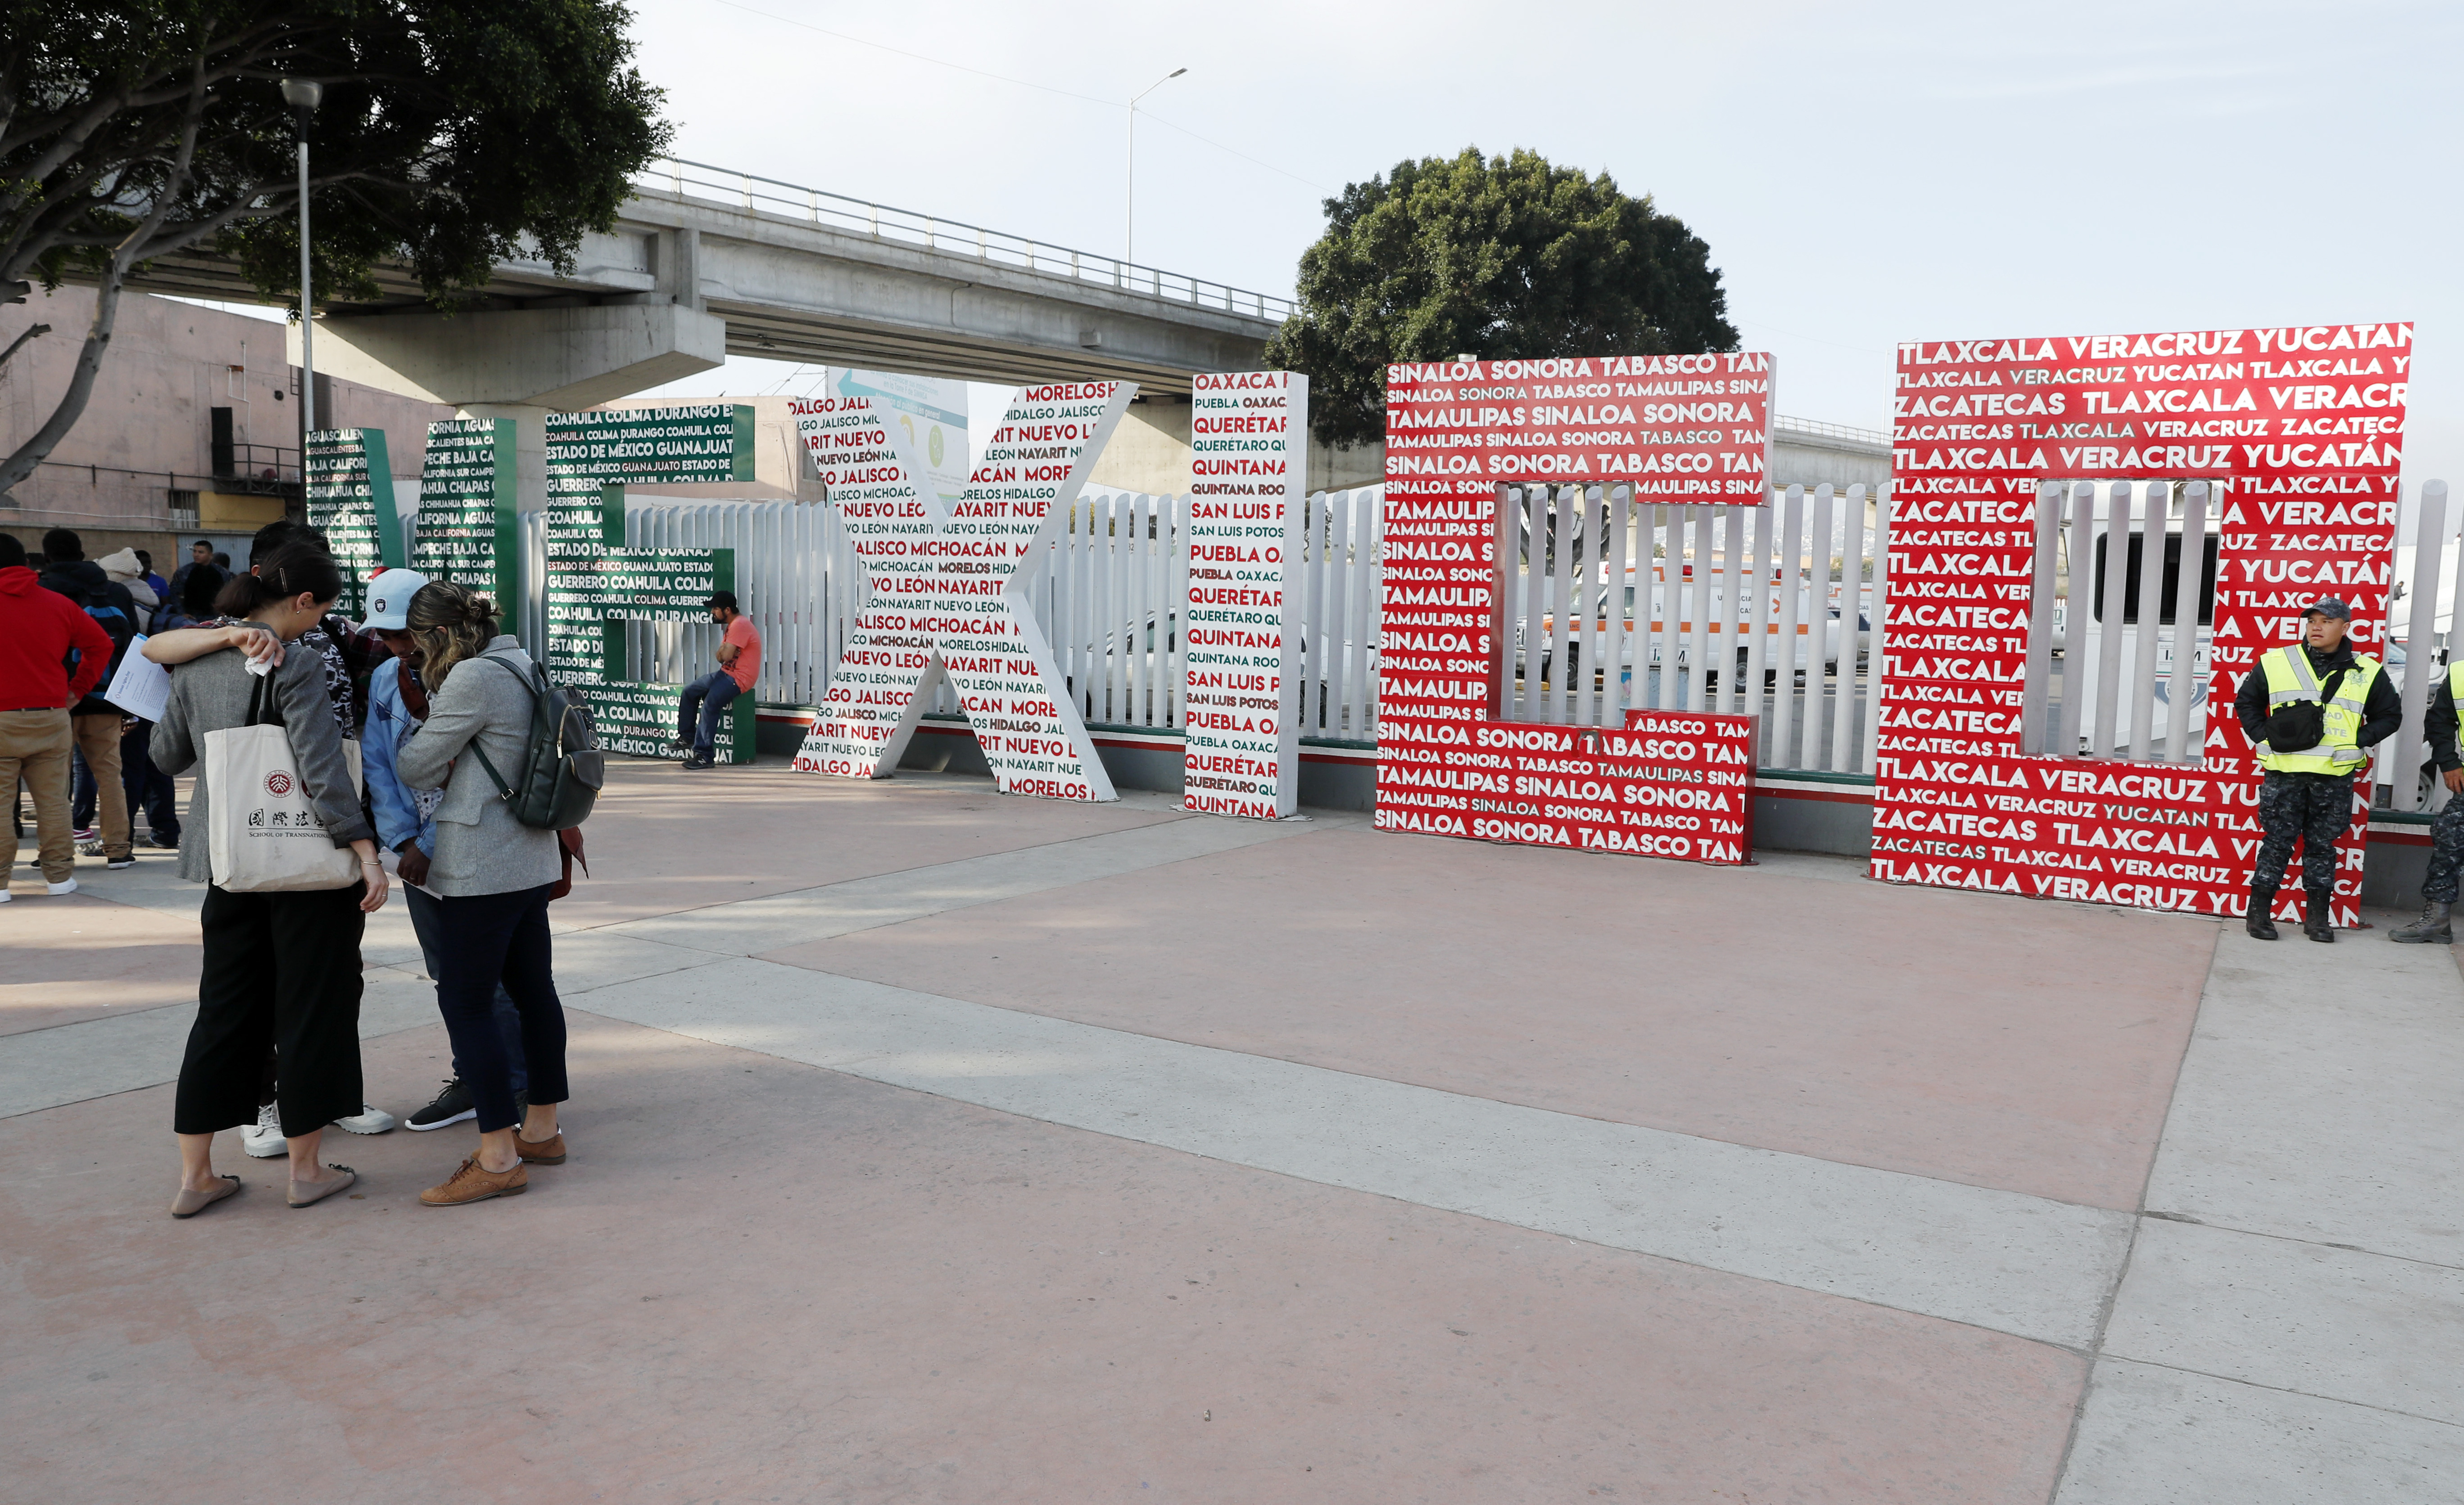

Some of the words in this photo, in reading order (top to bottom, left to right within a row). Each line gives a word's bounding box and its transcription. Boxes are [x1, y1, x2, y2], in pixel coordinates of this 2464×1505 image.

[1898, 338, 2058, 365] TLAXCALA
[2067, 330, 2244, 360] VERACRUZ
[1387, 362, 1485, 384] SINALOA
[1490, 358, 1598, 380] SONORA
[1599, 355, 1717, 377] TABASCO
[1895, 370, 2002, 389] TLAXCALA
[2009, 366, 2126, 385] VERACRUZ
[2132, 362, 2244, 382] YUCATAN
[2249, 357, 2384, 379] TLAXCALA
[1195, 373, 1276, 390] OAXACA
[1026, 382, 1106, 402] MORELOS
[1387, 388, 1455, 403] SINALOA
[1459, 386, 1528, 401] SONORA
[1533, 383, 1611, 399] TABASCO
[1615, 380, 1725, 397] TAMAULIPAS
[1195, 398, 1239, 409] PUEBLA
[1893, 392, 2066, 418] ZACATECAS
[2082, 387, 2257, 414] TLAXCALA
[545, 411, 603, 426] COAHUILA
[605, 409, 652, 423] COLIMA
[654, 406, 720, 421] DURANGO
[820, 415, 860, 429] JALISCO
[1386, 406, 1526, 429] TAMAULIPAS
[1531, 404, 1637, 426] SINALOA
[1643, 402, 1754, 424] SONORA
[545, 431, 585, 442] COAHUILA
[586, 429, 619, 440] COLIMA
[620, 427, 665, 439] DURANGO
[666, 425, 712, 437] COAHUILA
[835, 430, 885, 448] NUEVO
[1019, 424, 1077, 442] NUEVO
[1385, 433, 1483, 448] TAMAULIPAS
[1486, 432, 1558, 447] SINALOA
[1561, 431, 1636, 446] SONORA
[1640, 430, 1722, 445] TABASCO
[1892, 423, 2014, 442] ZACATECAS
[2019, 422, 2135, 439] TLAXCALA
[2142, 419, 2269, 438] VERACRUZ
[986, 446, 1015, 461] LEÓN
[1018, 446, 1067, 460] NAYARIT
[1193, 440, 1268, 451] QUERÉTARO
[816, 453, 851, 466] NUEVO
[853, 448, 880, 463] LEÓN
[1596, 453, 1713, 473] TABASCO
[1891, 447, 2049, 470] TLAXCALA
[2059, 445, 2233, 469] VERACRUZ
[545, 463, 575, 475] ESTADO
[576, 463, 587, 474] DE
[588, 460, 620, 474] MÉXICO
[622, 461, 680, 472] GUANAJUATO
[682, 459, 717, 471] ESTADO
[718, 459, 730, 470] DE
[320, 473, 354, 482] CALIFORNIA
[355, 472, 366, 481] SUR
[2241, 476, 2372, 494] TLAXCALA
[449, 480, 490, 494] CHIAPAS
[1191, 483, 1255, 495] QUINTANA
[1258, 484, 1284, 495] ROO
[425, 499, 461, 508] CHIHUAHUA
[462, 498, 490, 508] CHIAPAS
[1191, 502, 1227, 518] SAN
[1233, 503, 1270, 519] LUIS
[433, 528, 471, 537] CALIFORNIA
[862, 521, 889, 534] LEÓN
[911, 537, 1006, 557] MICHOACÁN
[1887, 530, 2006, 547] ZACATECAS
[452, 542, 478, 555] BAJA
[1190, 544, 1261, 563] PUEBLA
[869, 559, 933, 572] MICHOACÁN
[938, 562, 991, 574] MORELOS
[1189, 568, 1233, 580] PUEBLA
[548, 574, 609, 589] GUERRERO
[610, 575, 672, 591] COAHUILA
[896, 574, 935, 593] LEÓN
[938, 579, 1003, 596] NAYARIT
[548, 592, 589, 603] GUERRERO
[590, 593, 633, 604] COAHUILA
[634, 595, 667, 605] COLIMA
[1188, 609, 1262, 624] QUERÉTARO
[869, 634, 934, 649] MICHOACÁN
[939, 639, 990, 652] MORELOS
[1187, 652, 1249, 666] QUINTANA
[1253, 656, 1280, 668] ROO
[1186, 670, 1222, 688] SAN
[1227, 673, 1265, 691] LUIS
[835, 707, 877, 721] JALISCO
[1185, 711, 1255, 733] PUEBLA
[990, 718, 1041, 733] HIDALGO
[1006, 737, 1064, 756] NUEVO
[1377, 746, 1441, 764] SINALOA
[1445, 751, 1513, 770] SONORA
[1516, 756, 1594, 775] TABASCO
[1597, 762, 1703, 783] TAMAULIPAS
[1009, 777, 1087, 799] MORELOS
[1184, 775, 1257, 794] QUERÉTARO
[1875, 756, 2029, 789] TLAXCALA
[2038, 768, 2207, 803] VERACRUZ
[1184, 794, 1275, 820] QUINTANA
[1376, 789, 1468, 810] TAMAULIPAS
[1471, 798, 1540, 816] SINALOA
[1544, 804, 1616, 824] SONORA
[1620, 810, 1701, 831] TABASCO
[1874, 785, 1978, 808] TLAXCALA
[1984, 794, 2097, 818] VERACRUZ
[2103, 804, 2208, 827] YUCATAN
[1375, 808, 1467, 835] SINALOA
[1473, 818, 1572, 845] SONORA
[1578, 827, 1690, 856] TABASCO
[1872, 807, 2037, 842] ZACATECAS
[2053, 822, 2220, 859] TLAXCALA
[1871, 835, 1986, 860] ZACATECAS
[1991, 846, 2103, 872] TLAXCALA
[2110, 857, 2231, 884] VERACRUZ
[1870, 857, 2022, 893] TLAXCALA
[2031, 873, 2198, 913] VERACRUZ
